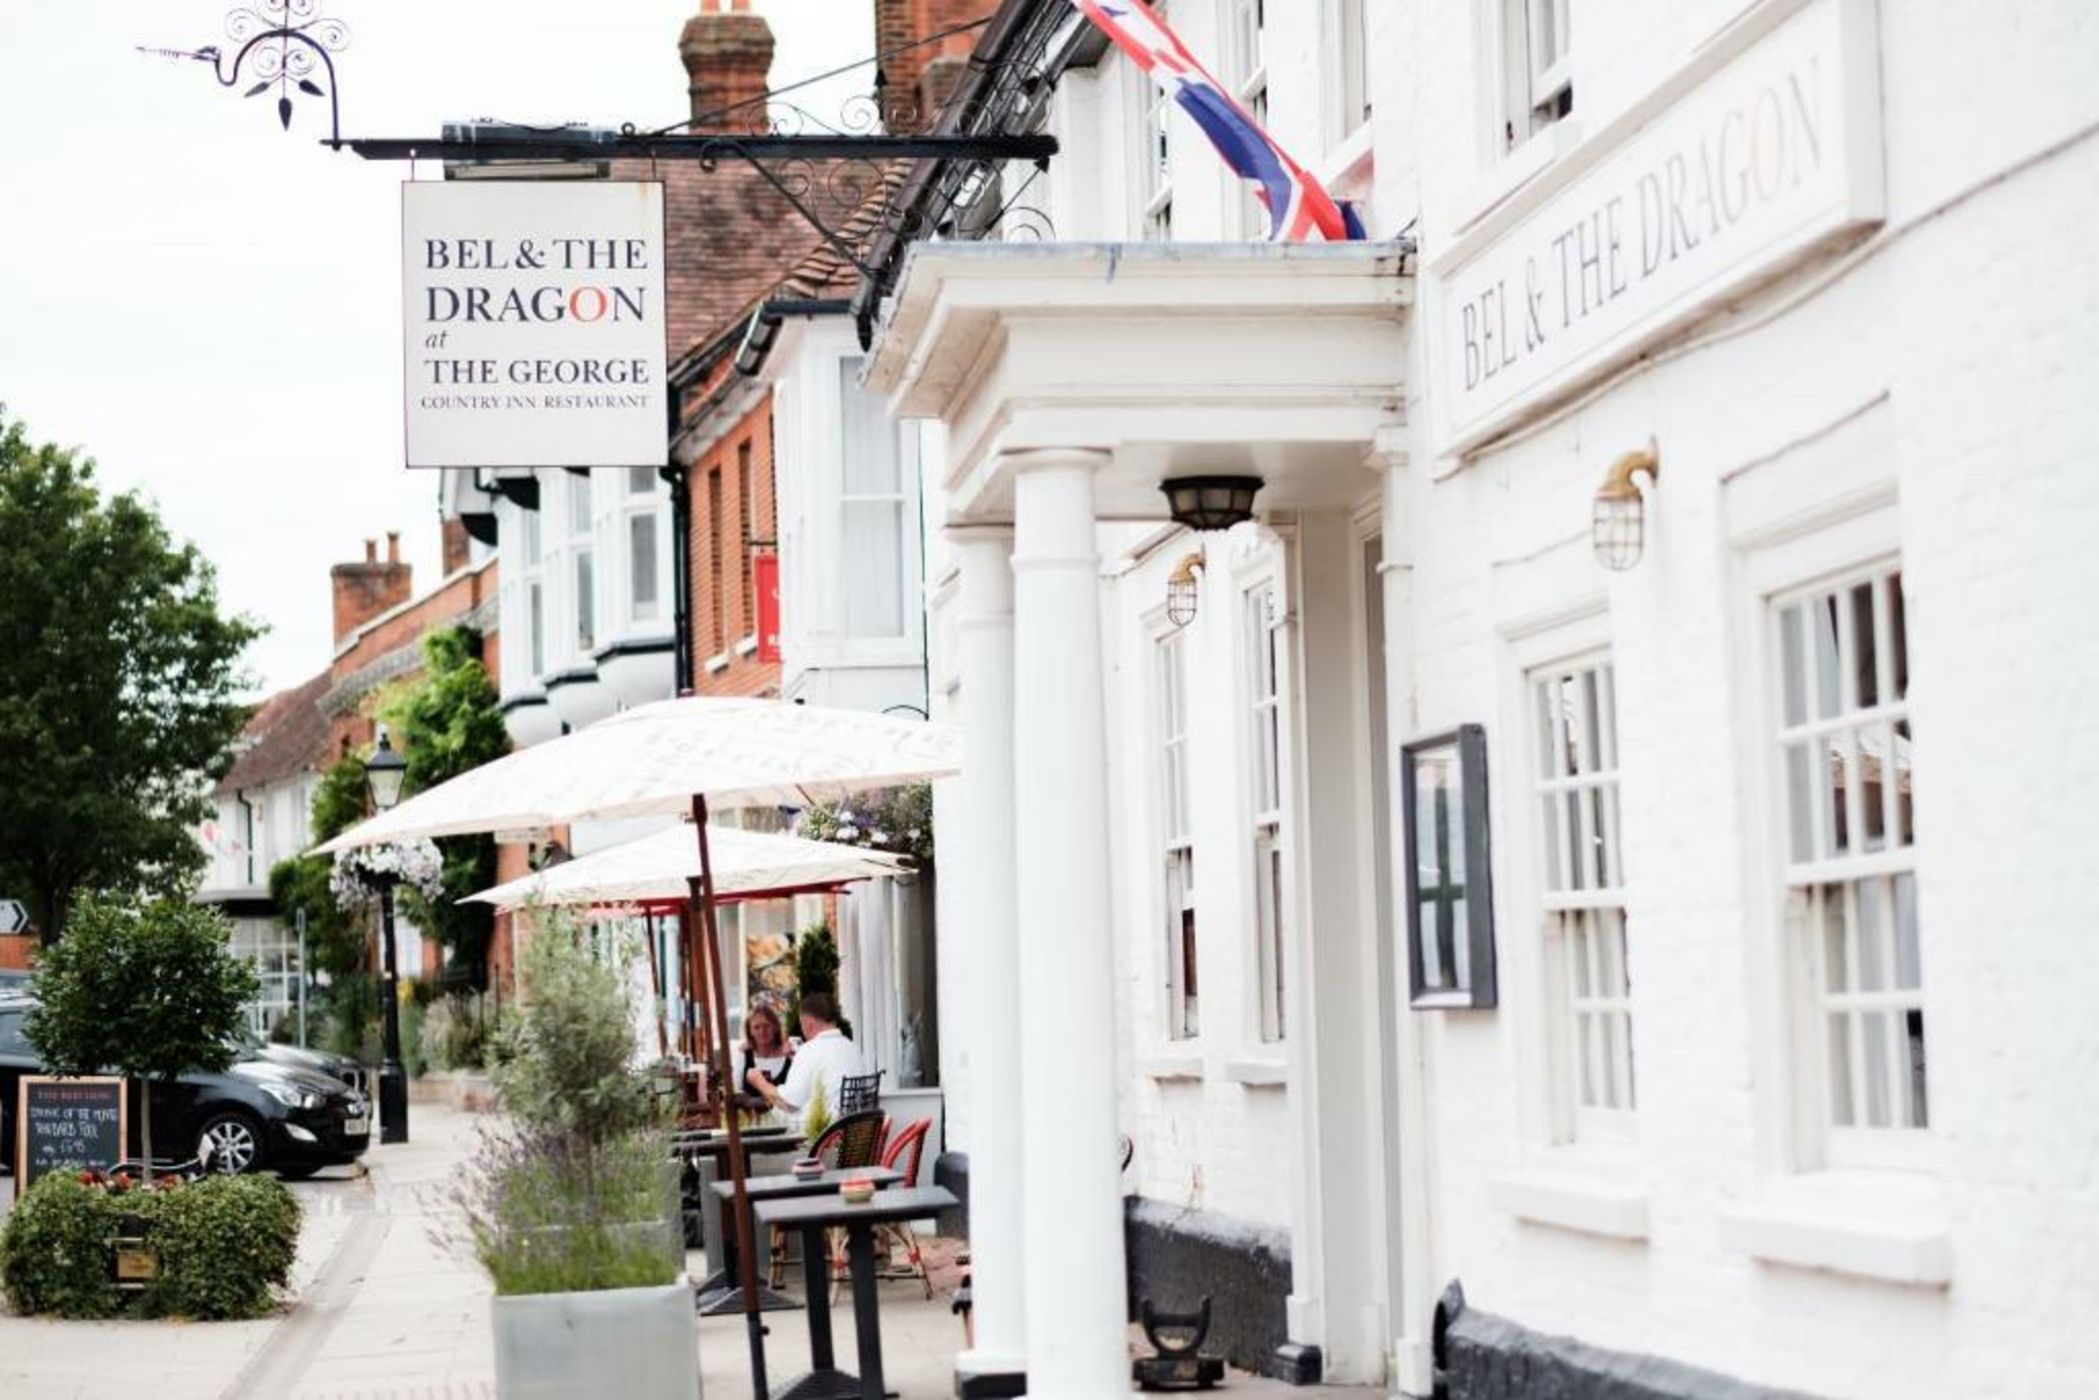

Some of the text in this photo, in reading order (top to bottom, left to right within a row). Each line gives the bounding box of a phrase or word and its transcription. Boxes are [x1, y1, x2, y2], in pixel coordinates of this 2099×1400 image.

[1462, 54, 1822, 392] BEL & THE DRAGON
[425, 286, 646, 323] DRAGON
[425, 330, 449, 349] at
[423, 358, 650, 385] THE GEORGE
[421, 395, 650, 409] COUNTRY INN RESTAURANT
